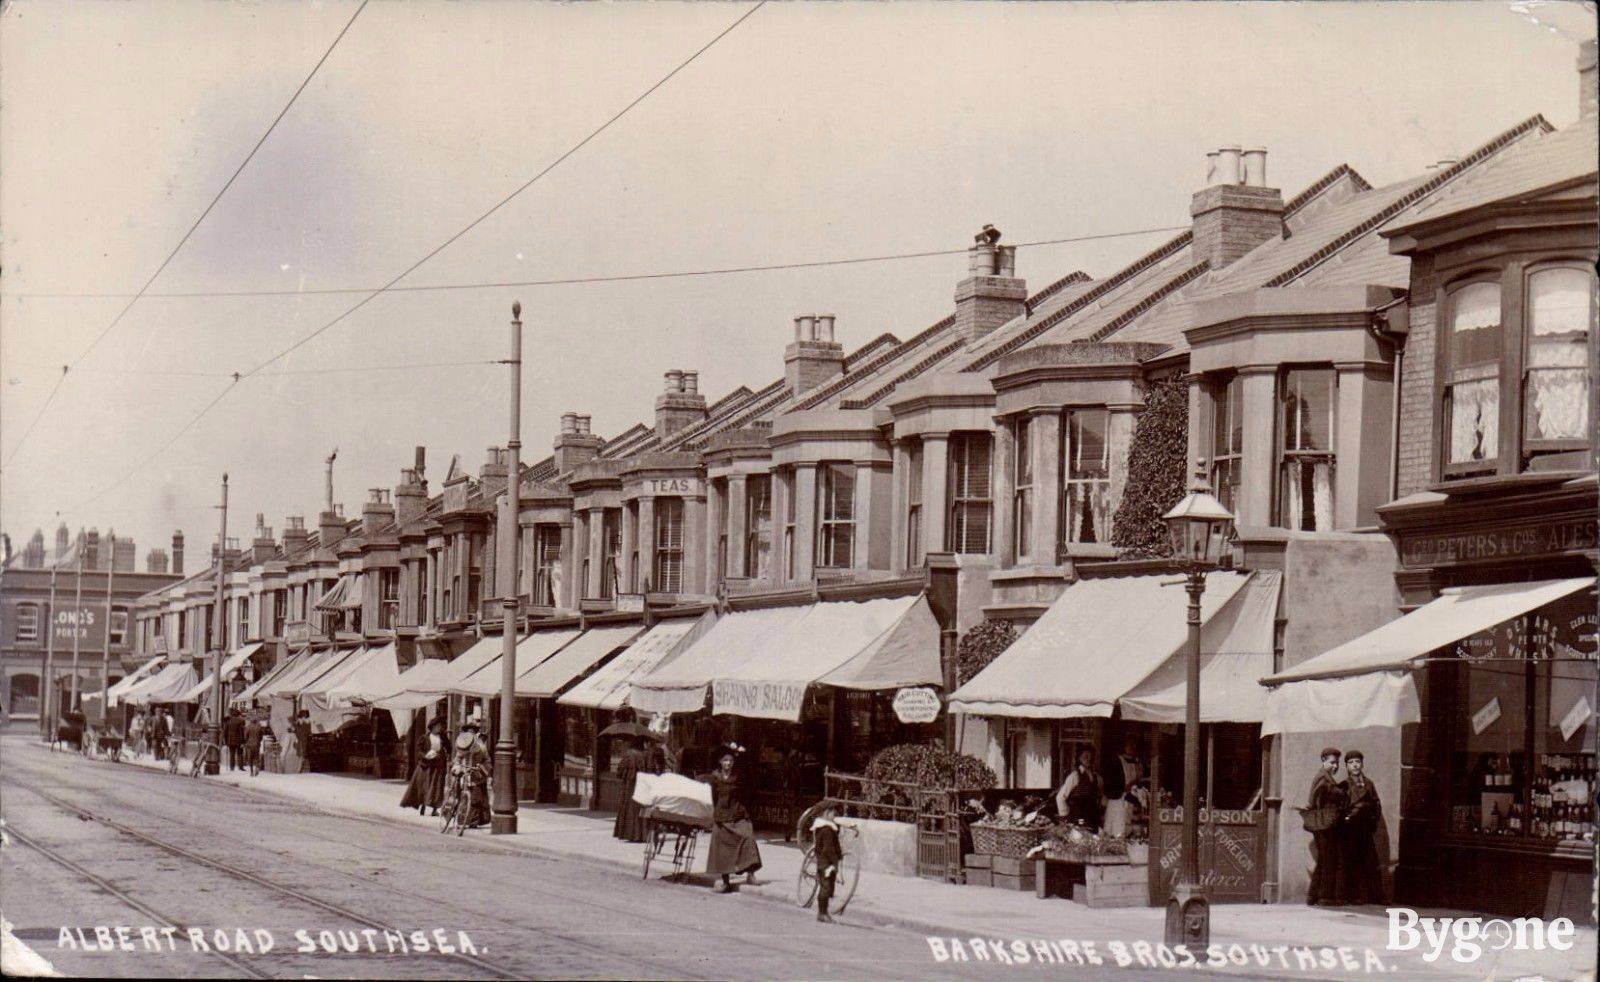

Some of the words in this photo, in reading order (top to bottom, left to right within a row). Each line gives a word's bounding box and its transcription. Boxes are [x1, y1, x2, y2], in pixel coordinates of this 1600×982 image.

[1437, 534, 1497, 562] PETERS
[1547, 523, 1596, 551] ALES
[1198, 809, 1255, 824] OPSON.
